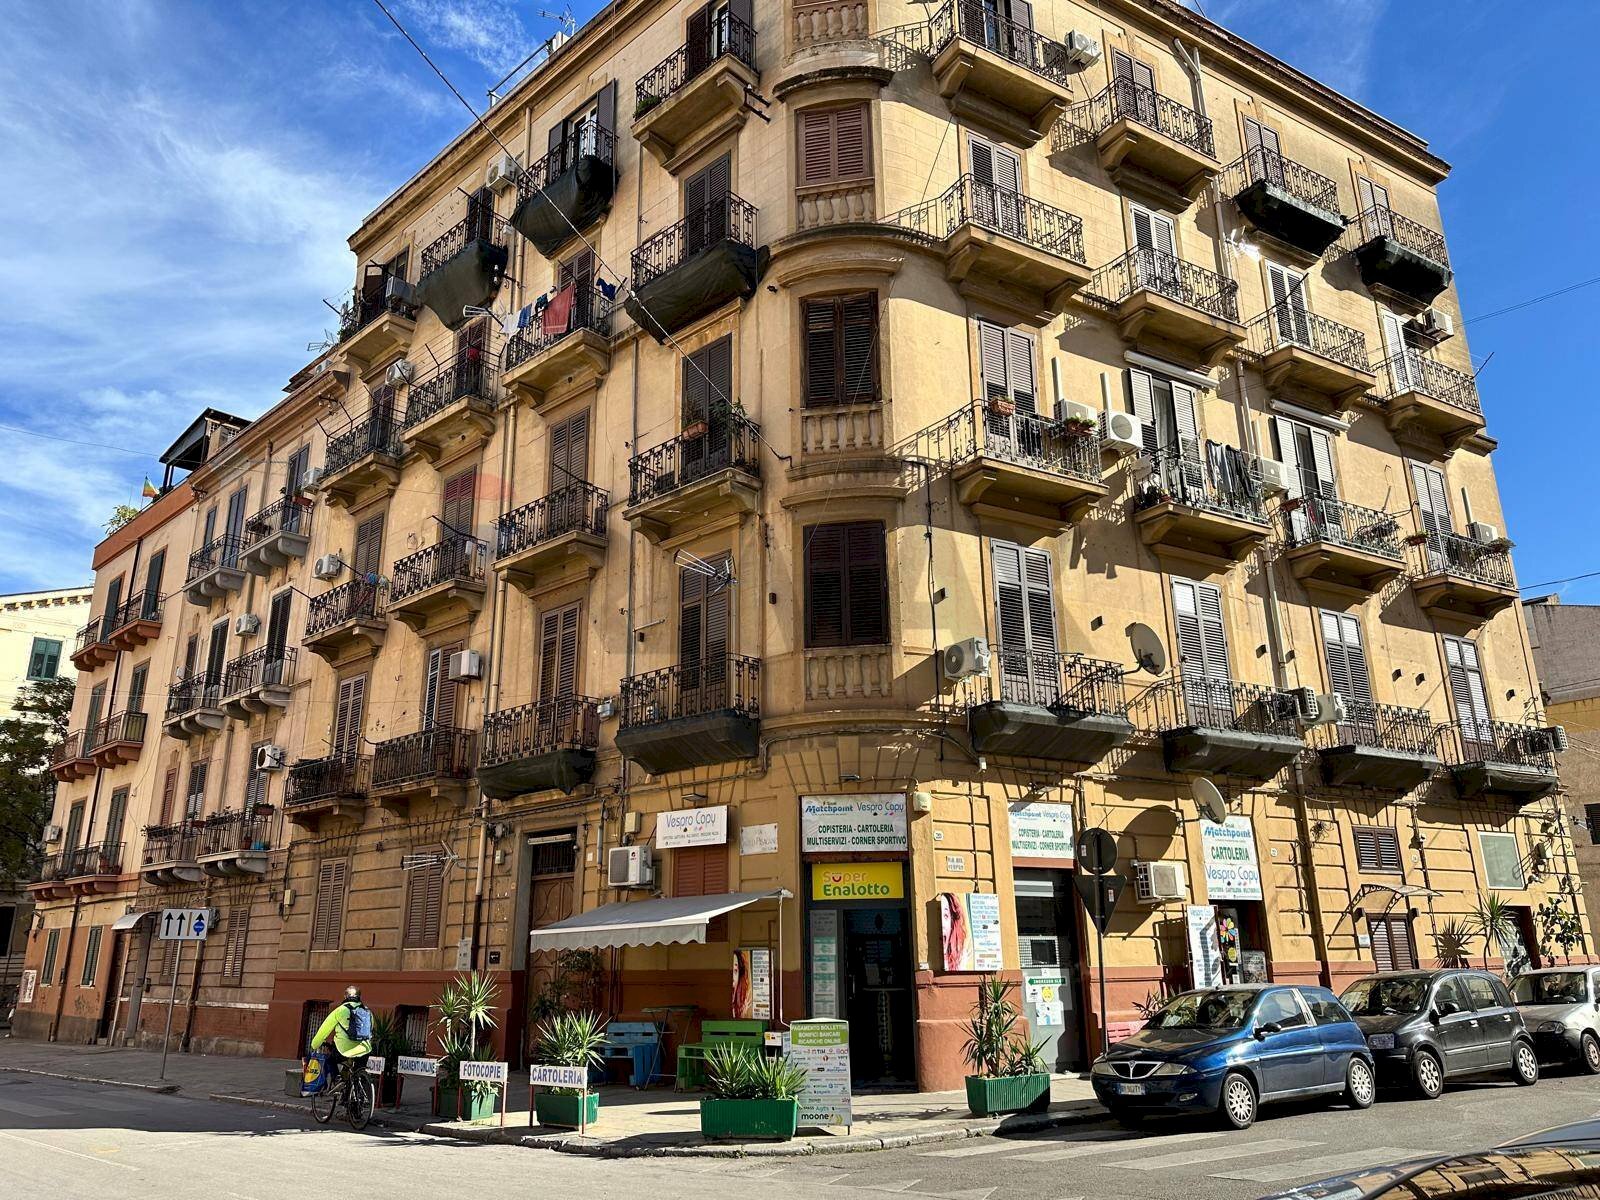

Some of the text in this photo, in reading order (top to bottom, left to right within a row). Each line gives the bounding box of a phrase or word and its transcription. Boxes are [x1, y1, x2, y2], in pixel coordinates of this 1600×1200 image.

[805, 805, 853, 813] Matchpoint
[856, 801, 904, 813] Vespro Copy
[666, 811, 716, 830] Vespro Copy
[1043, 810, 1059, 819] Vespro
[818, 824, 853, 834] COPISTERIA
[857, 824, 894, 833] CARTOLERIA
[1018, 828, 1040, 838] COPISTERIA
[1042, 830, 1064, 839] CARTOLERIA
[1204, 826, 1251, 839] Matchpoint
[806, 837, 847, 846] MULTISERVIZI
[851, 836, 876, 845] CORNER
[877, 835, 907, 845] SPORTIVO
[1012, 840, 1037, 850] MULTISERVIZI
[1040, 841, 1054, 850] CORNER
[1054, 842, 1073, 851] SPORTIVO
[1211, 846, 1250, 861] CARTOLERIA
[1206, 865, 1258, 883] Vespro Copy
[823, 883, 890, 896] Enalotto
[399, 1059, 420, 1072] PAGAMENTI
[463, 1062, 502, 1079] FOTOCOPIE
[531, 1066, 584, 1084] CARTOLERIA
